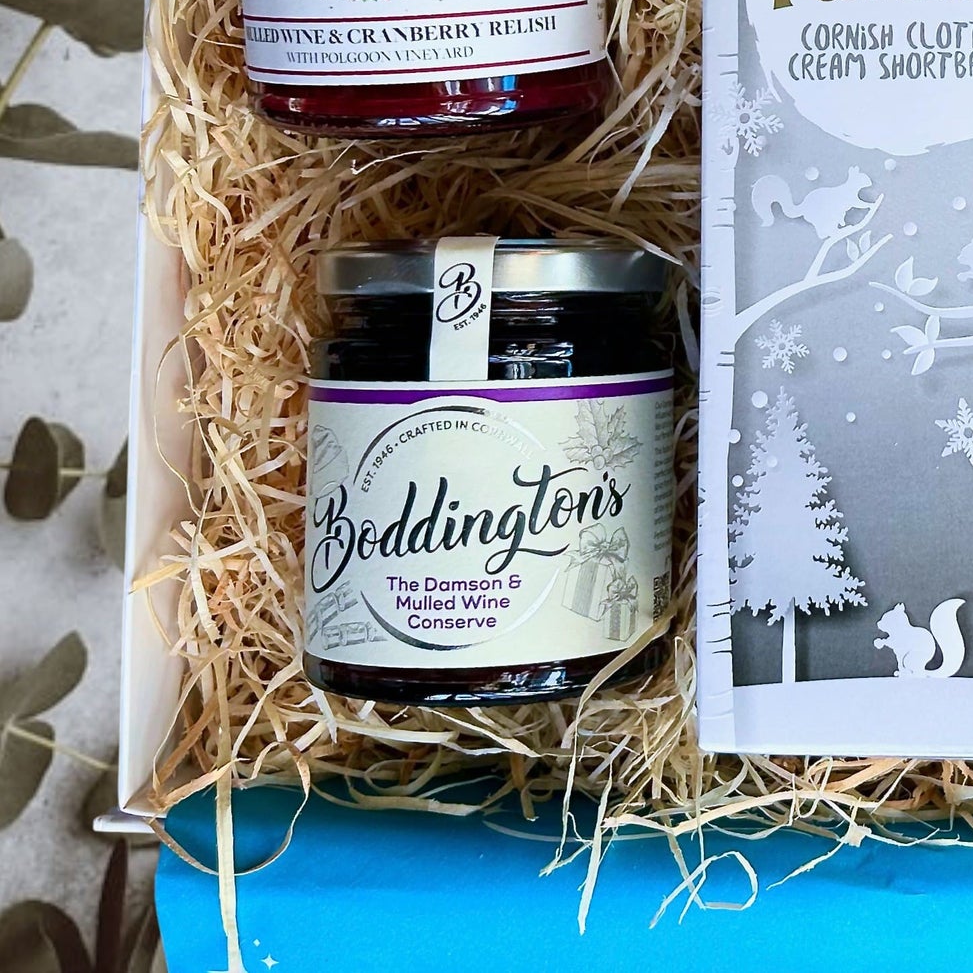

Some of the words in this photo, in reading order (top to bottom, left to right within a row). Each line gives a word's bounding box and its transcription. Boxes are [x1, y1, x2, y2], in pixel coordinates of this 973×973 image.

[280, 28, 326, 45] WINE
[329, 29, 344, 45] &
[347, 22, 483, 45] CRANBERRY
[489, 15, 557, 36] RELISH
[286, 51, 319, 63] WITH
[321, 50, 391, 64] POLGOON
[394, 45, 474, 62] VINEYARD
[788, 53, 865, 81] CREAM
[453, 319, 471, 331] EST.
[469, 303, 487, 321] 1946
[361, 471, 377, 493] EST.
[372, 444, 394, 469] 1946
[399, 420, 452, 444] CRAFTED
[455, 420, 468, 430] IN
[311, 464, 631, 593] Boddington's
[386, 576, 420, 593] The
[424, 576, 504, 593] Damson
[508, 574, 522, 589] &
[396, 594, 456, 610] Mulled
[461, 594, 511, 609] Wine
[407, 613, 497, 630] Conserve
